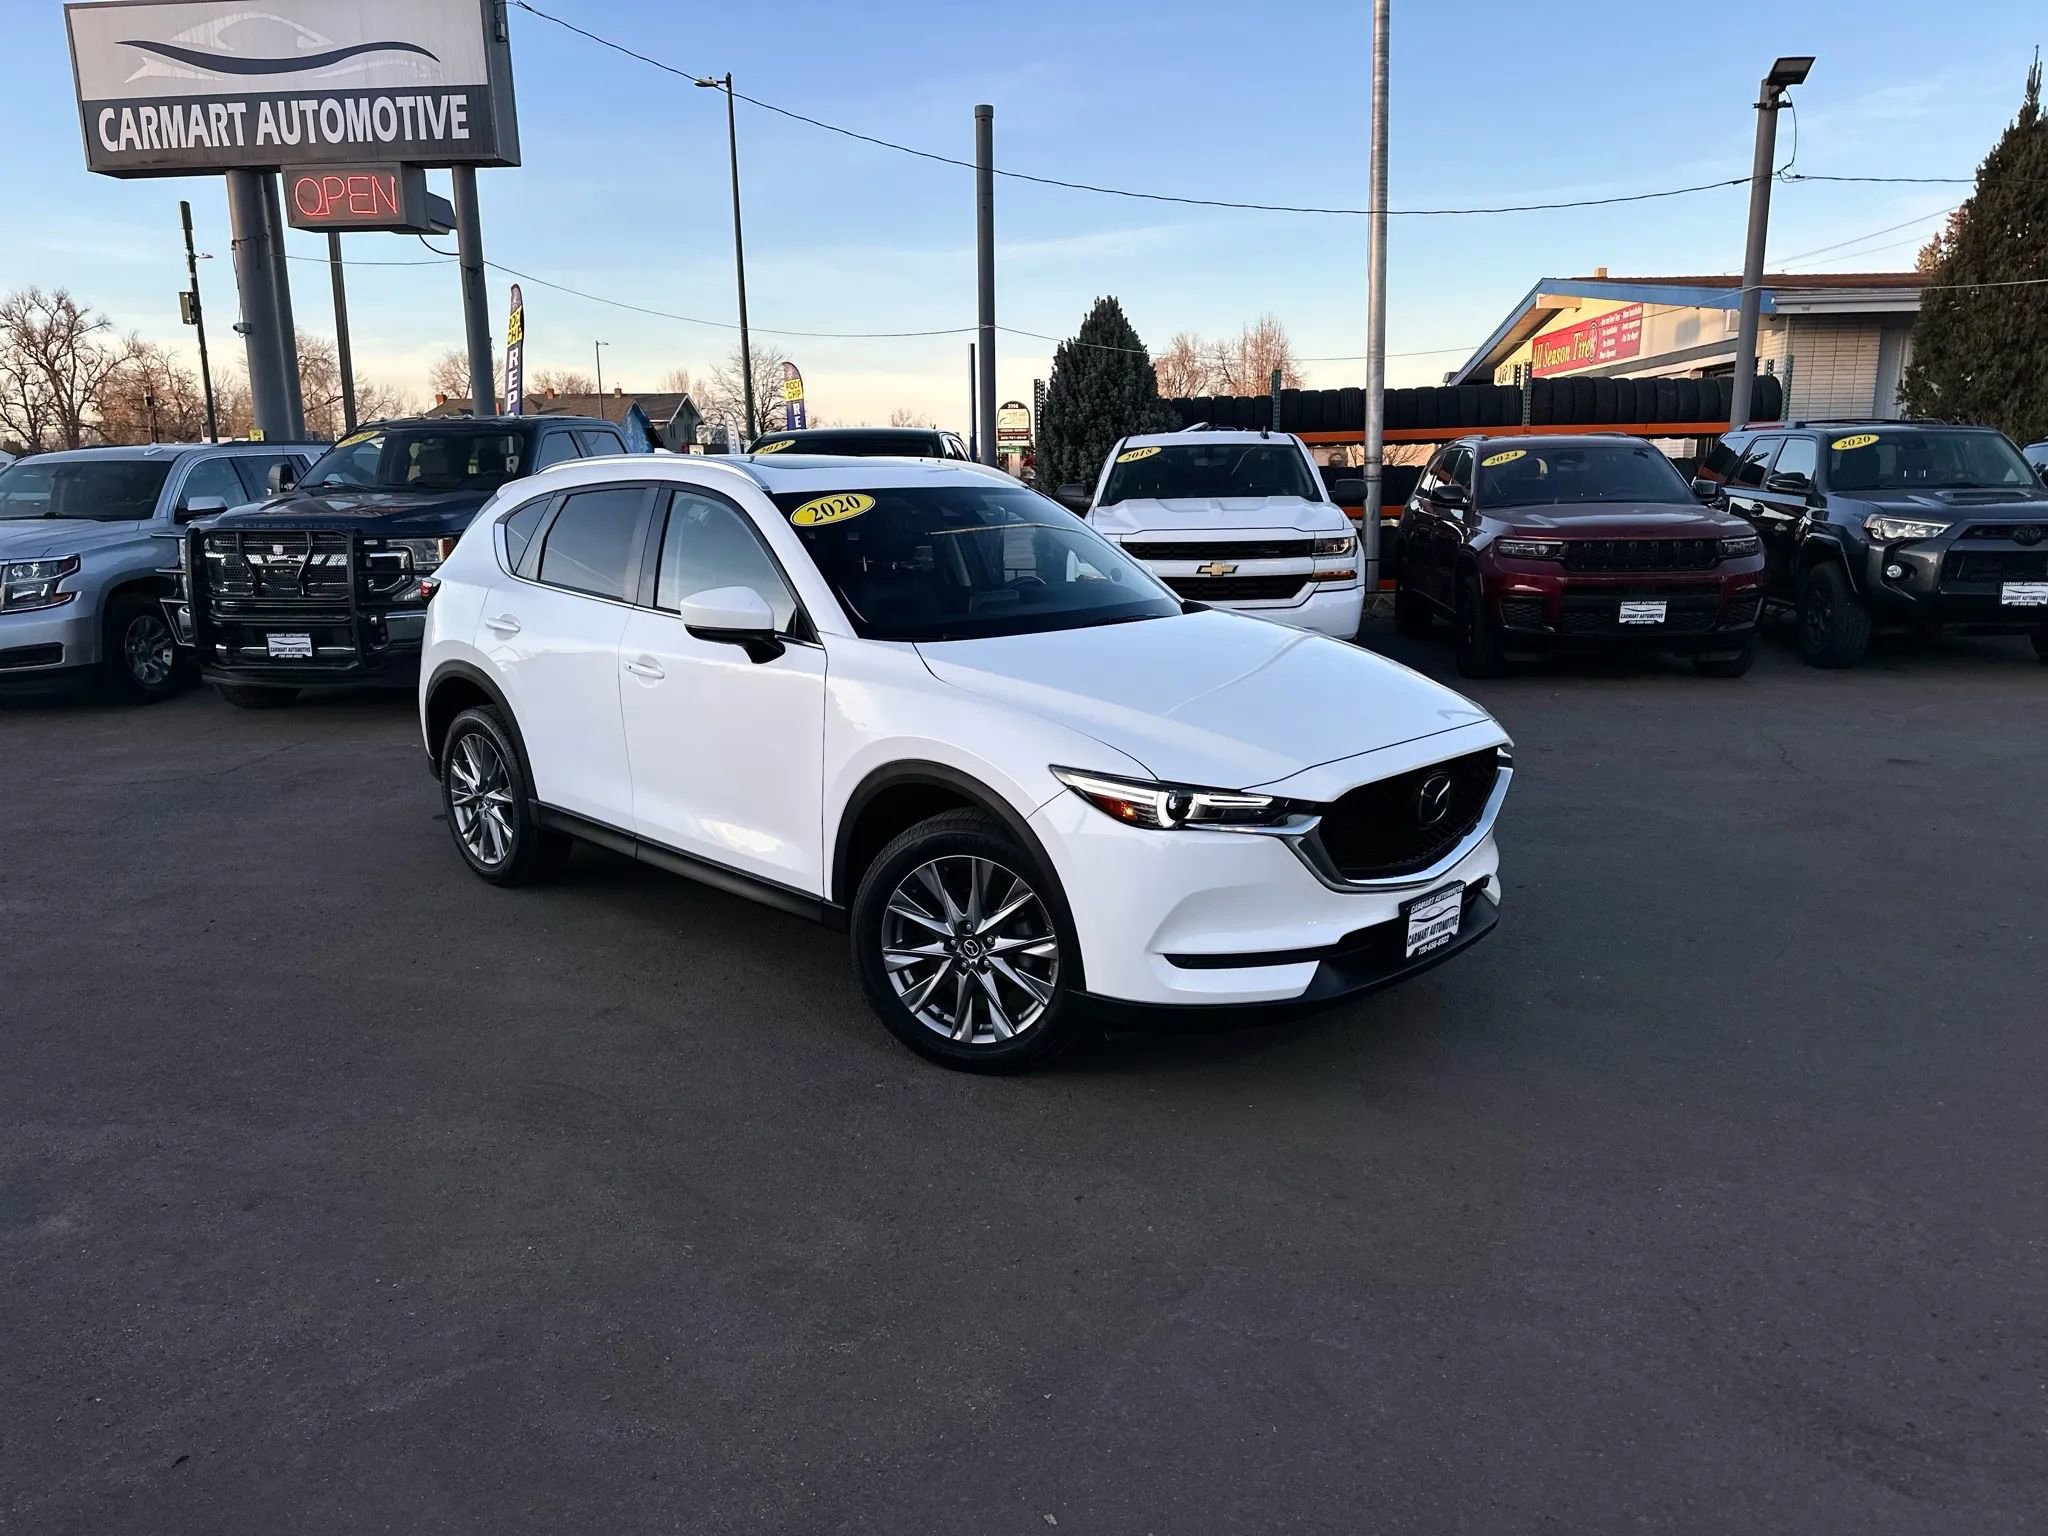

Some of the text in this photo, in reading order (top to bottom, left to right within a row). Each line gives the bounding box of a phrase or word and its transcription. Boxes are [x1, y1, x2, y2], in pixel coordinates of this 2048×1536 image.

[99, 94, 470, 152] CARMART AUTOMOTIVE
[294, 175, 398, 216] OPEN
[1532, 344, 1543, 369] All
[1543, 341, 1571, 368] Season
[1124, 448, 1153, 461] 2018
[1841, 435, 1871, 449] 2020
[1490, 451, 1518, 465] 2024
[806, 495, 861, 522] 2020
[1410, 883, 1466, 914] CARMART AUTOMOTIVE
[1407, 914, 1459, 947] CARMART AUTOMOTIVE
